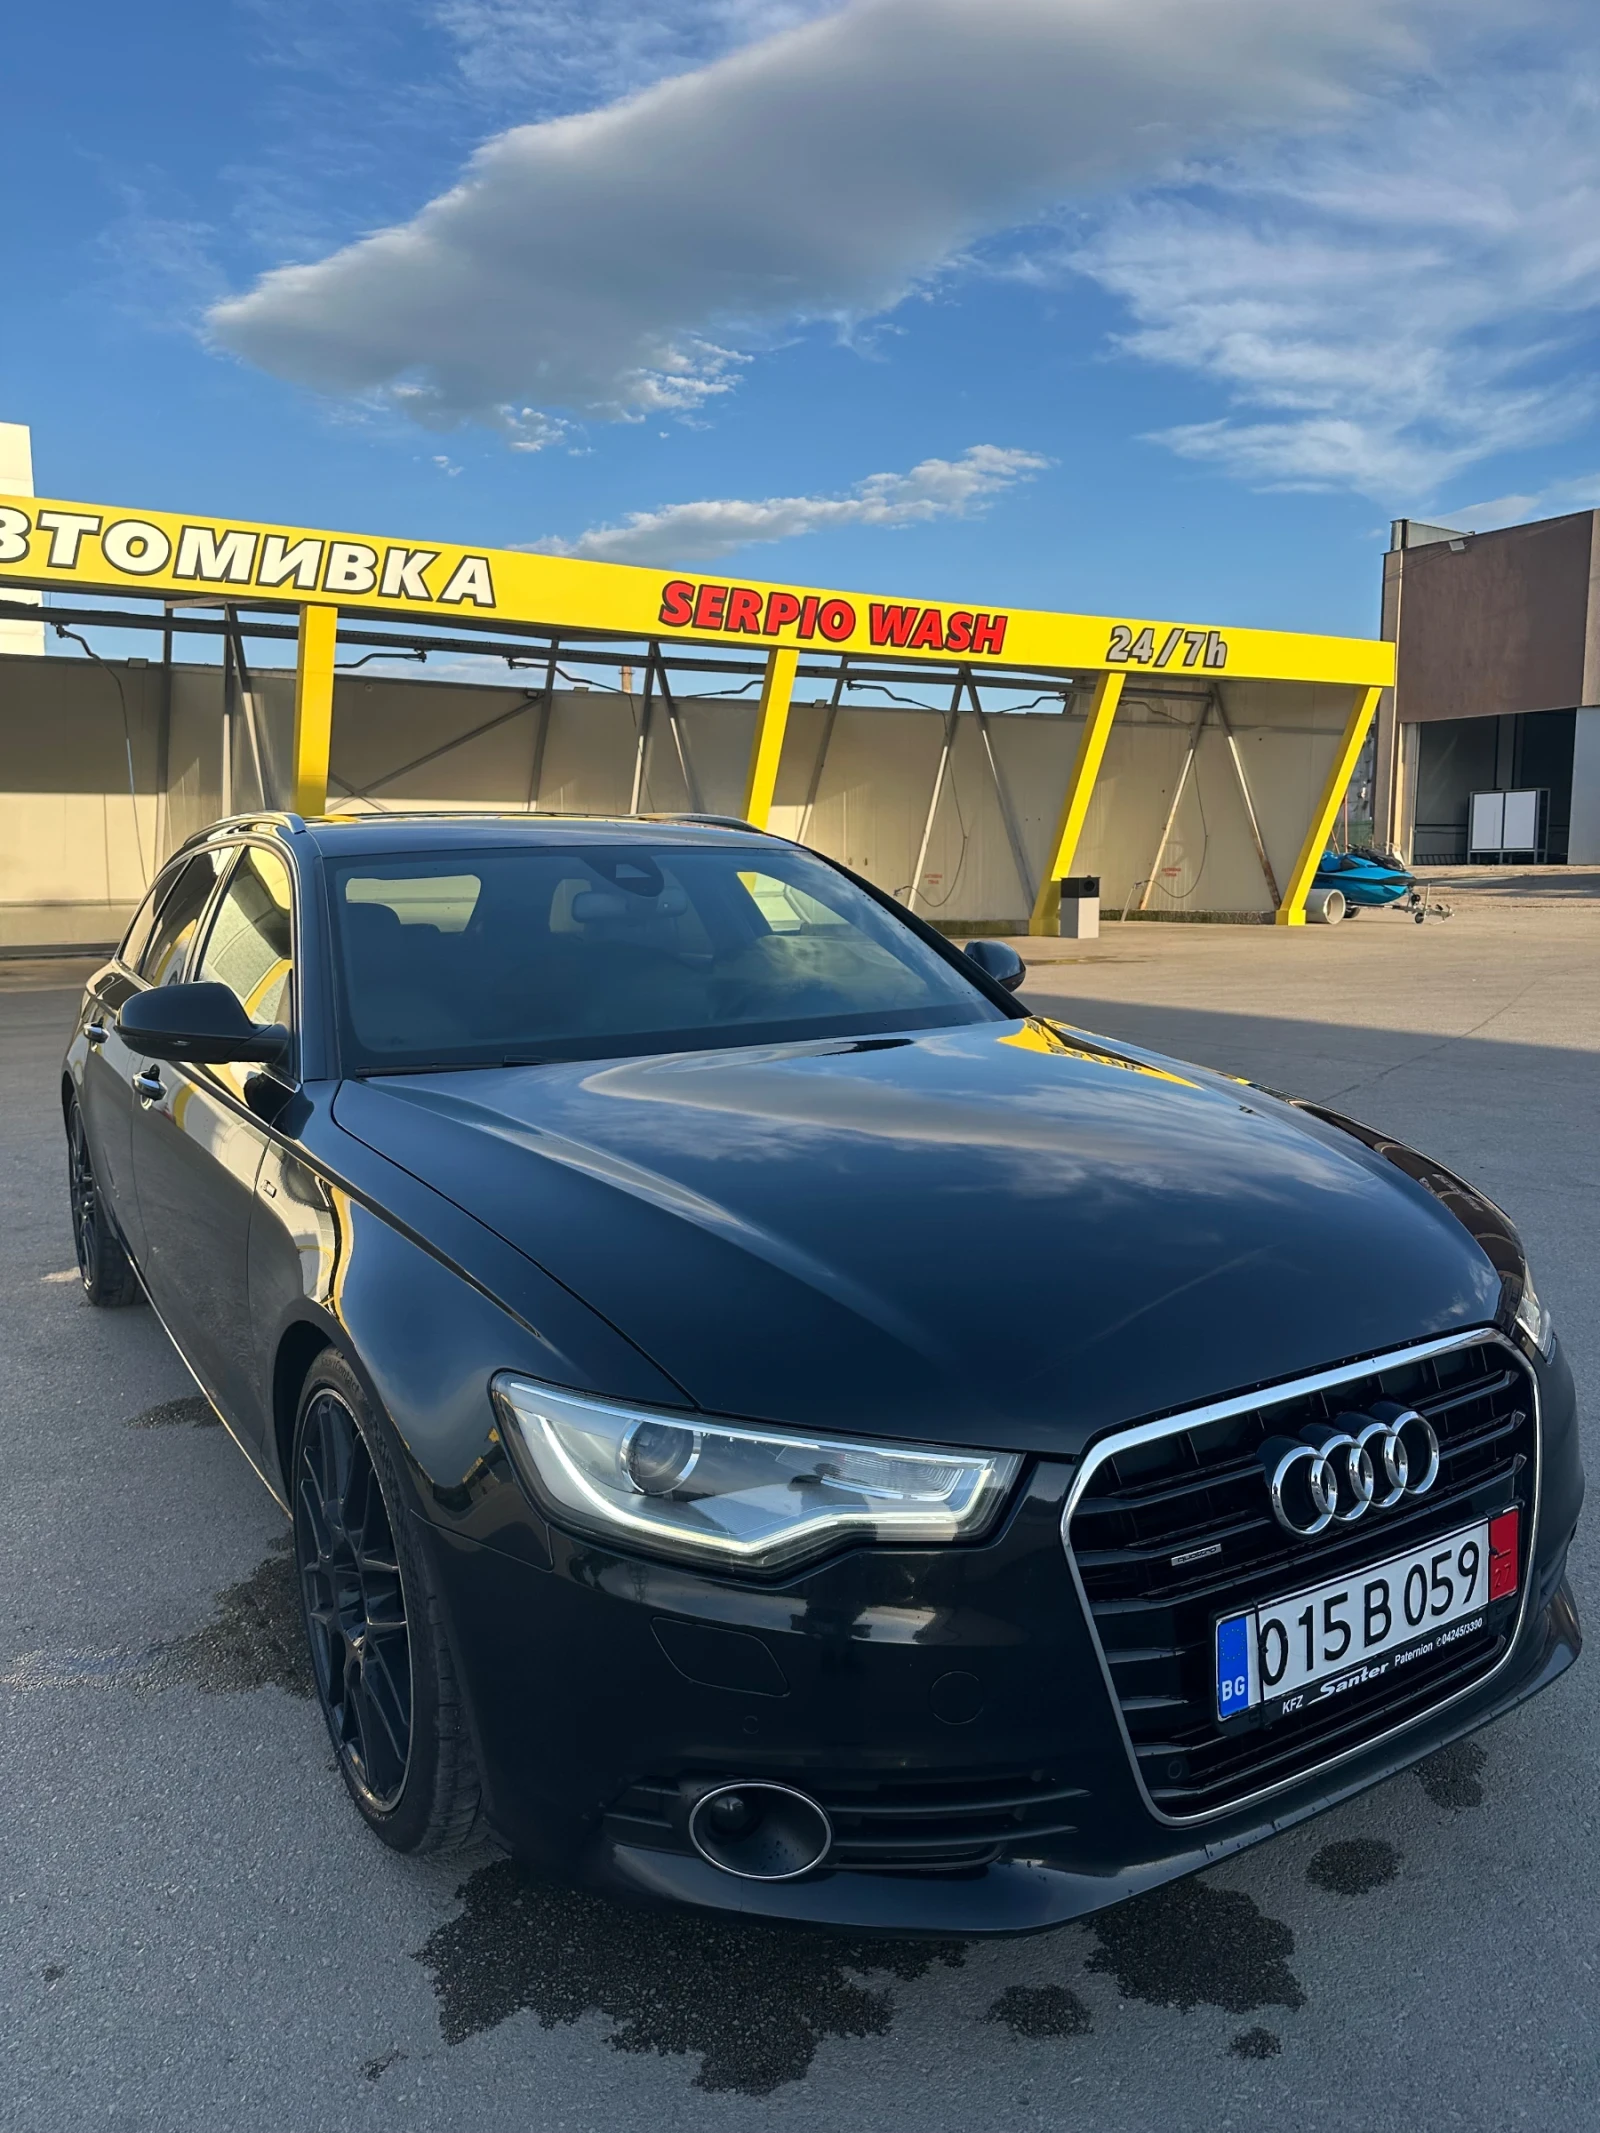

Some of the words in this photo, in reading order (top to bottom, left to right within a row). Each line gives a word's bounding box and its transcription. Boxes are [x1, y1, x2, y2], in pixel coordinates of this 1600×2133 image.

[658, 580, 856, 641] SERPIO
[868, 603, 1008, 655] WASH
[1105, 624, 1228, 669] 24/7h
[1221, 1675, 1246, 1702] BG
[1282, 1694, 1304, 1715] KFZ
[1307, 1662, 1389, 1706] Santer
[1394, 1641, 1433, 1667] Paternion
